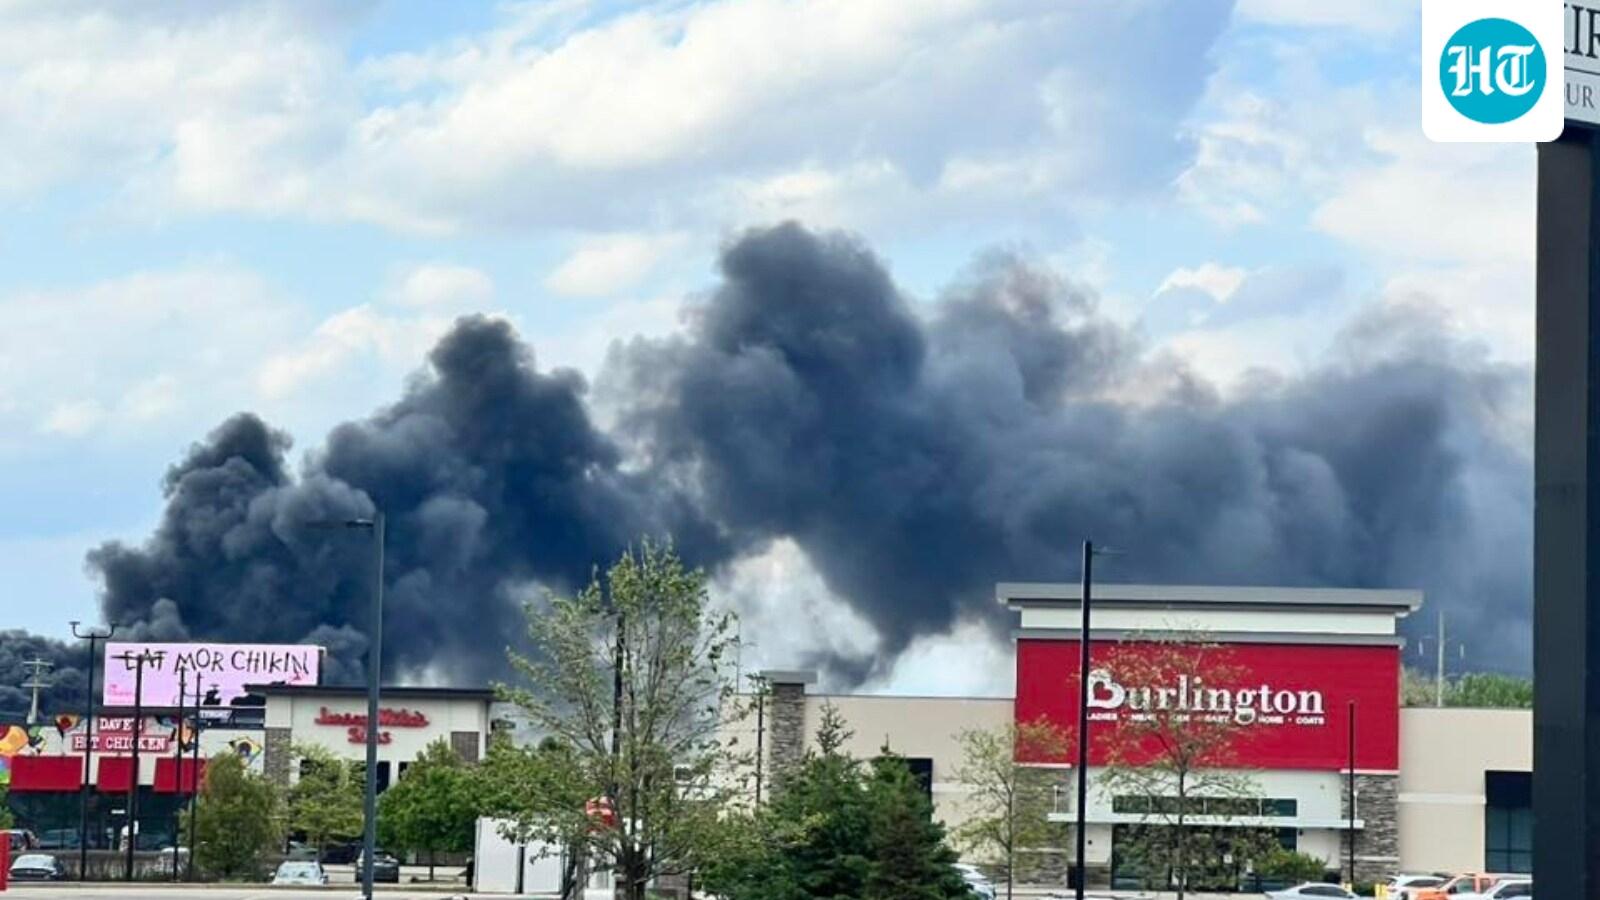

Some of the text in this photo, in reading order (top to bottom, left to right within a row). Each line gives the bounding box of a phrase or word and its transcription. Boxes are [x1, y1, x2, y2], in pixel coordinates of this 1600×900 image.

[1565, 82, 1594, 109] UR
[124, 648, 309, 675] EAT MOR CHIKIN
[1086, 669, 1325, 725] Burlington
